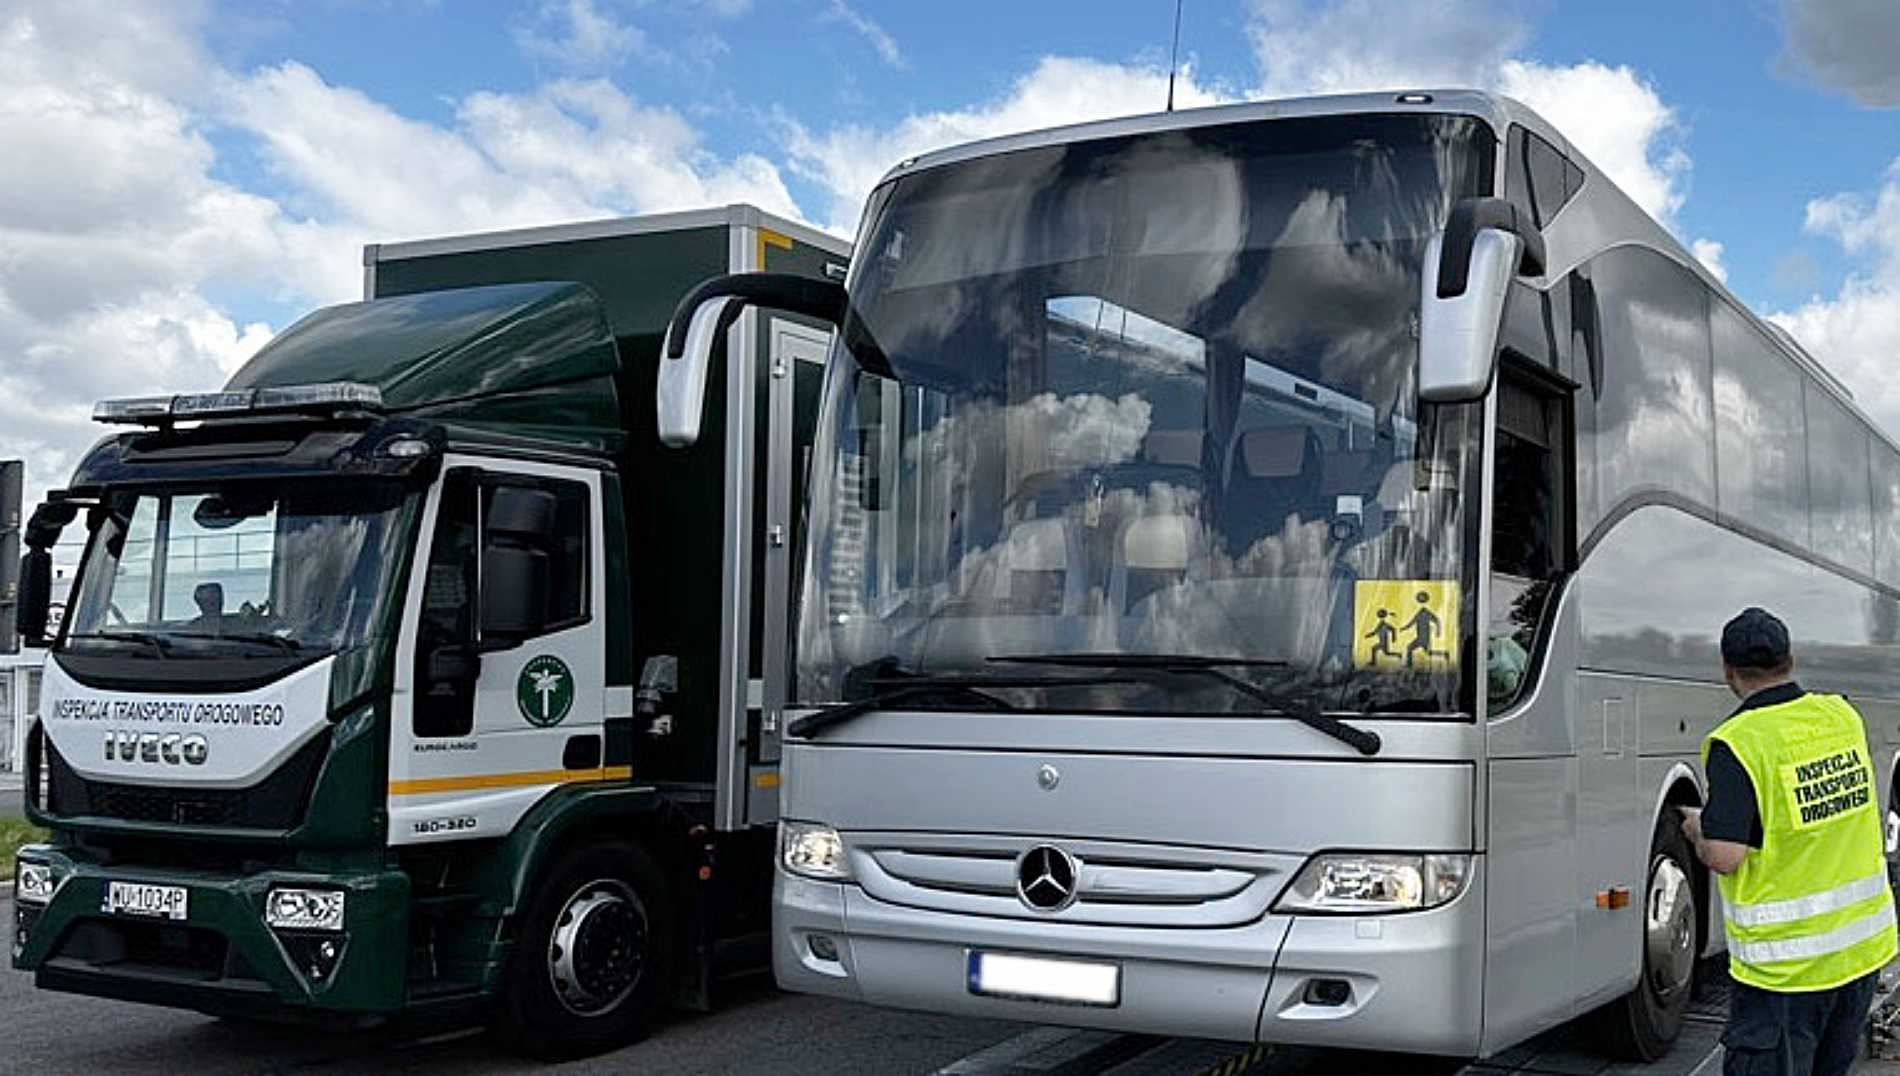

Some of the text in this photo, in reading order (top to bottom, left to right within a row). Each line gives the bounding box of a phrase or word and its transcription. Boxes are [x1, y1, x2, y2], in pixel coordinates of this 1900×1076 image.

[52, 699, 284, 726] INSPEKCJA TRANSPORTU DROGOWEGO
[104, 731, 209, 765] IVECO
[1795, 749, 1861, 783] INSPEKCJA
[1795, 766, 1868, 804] TRANSPORTU
[1800, 787, 1869, 824] DROGOWEGO
